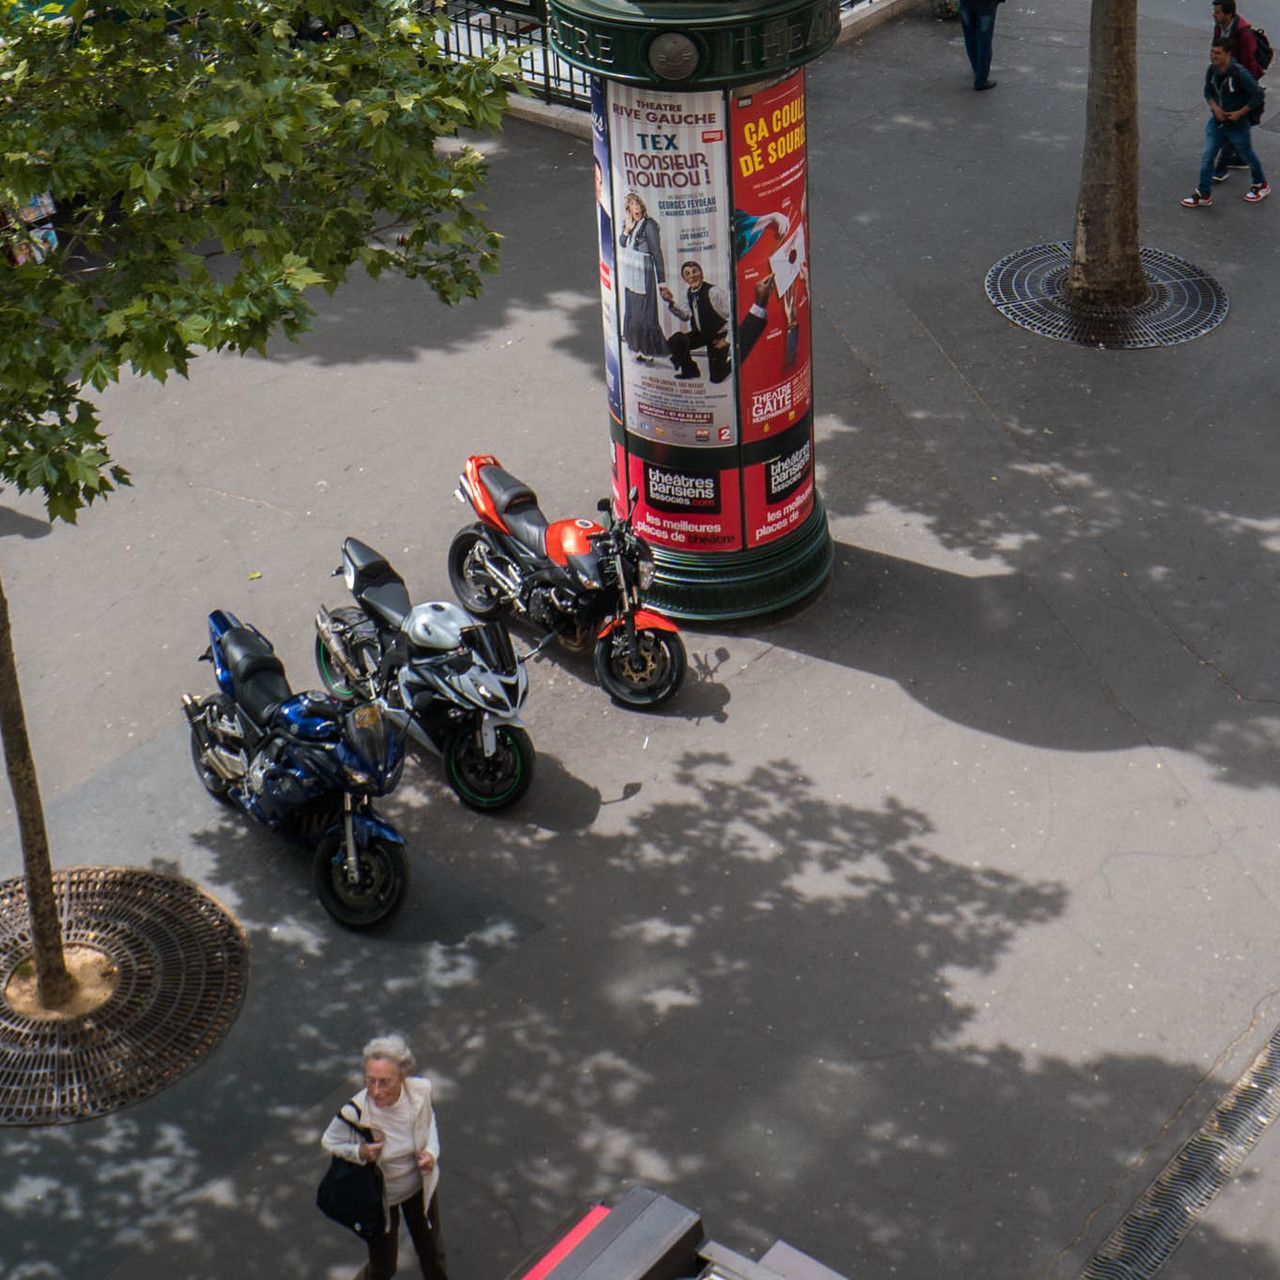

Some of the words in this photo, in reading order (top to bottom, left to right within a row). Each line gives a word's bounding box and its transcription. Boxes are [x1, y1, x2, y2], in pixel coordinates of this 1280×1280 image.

[613, 103, 641, 120] RIVE
[645, 112, 716, 125] GAUCHE
[636, 100, 682, 112] THEATRE
[637, 133, 679, 151] TEX
[744, 117, 769, 151] ÇA
[739, 149, 764, 177] DE
[752, 382, 791, 405] THEATRE
[721, 429, 730, 440] 2
[649, 468, 714, 489] théâtres
[650, 480, 714, 499] parisiens
[646, 512, 661, 526] les
[663, 519, 721, 533] meilleures
[756, 518, 788, 541] places
[789, 510, 799, 523] de
[767, 511, 782, 522] les
[637, 521, 669, 539] places
[670, 531, 685, 542] de
